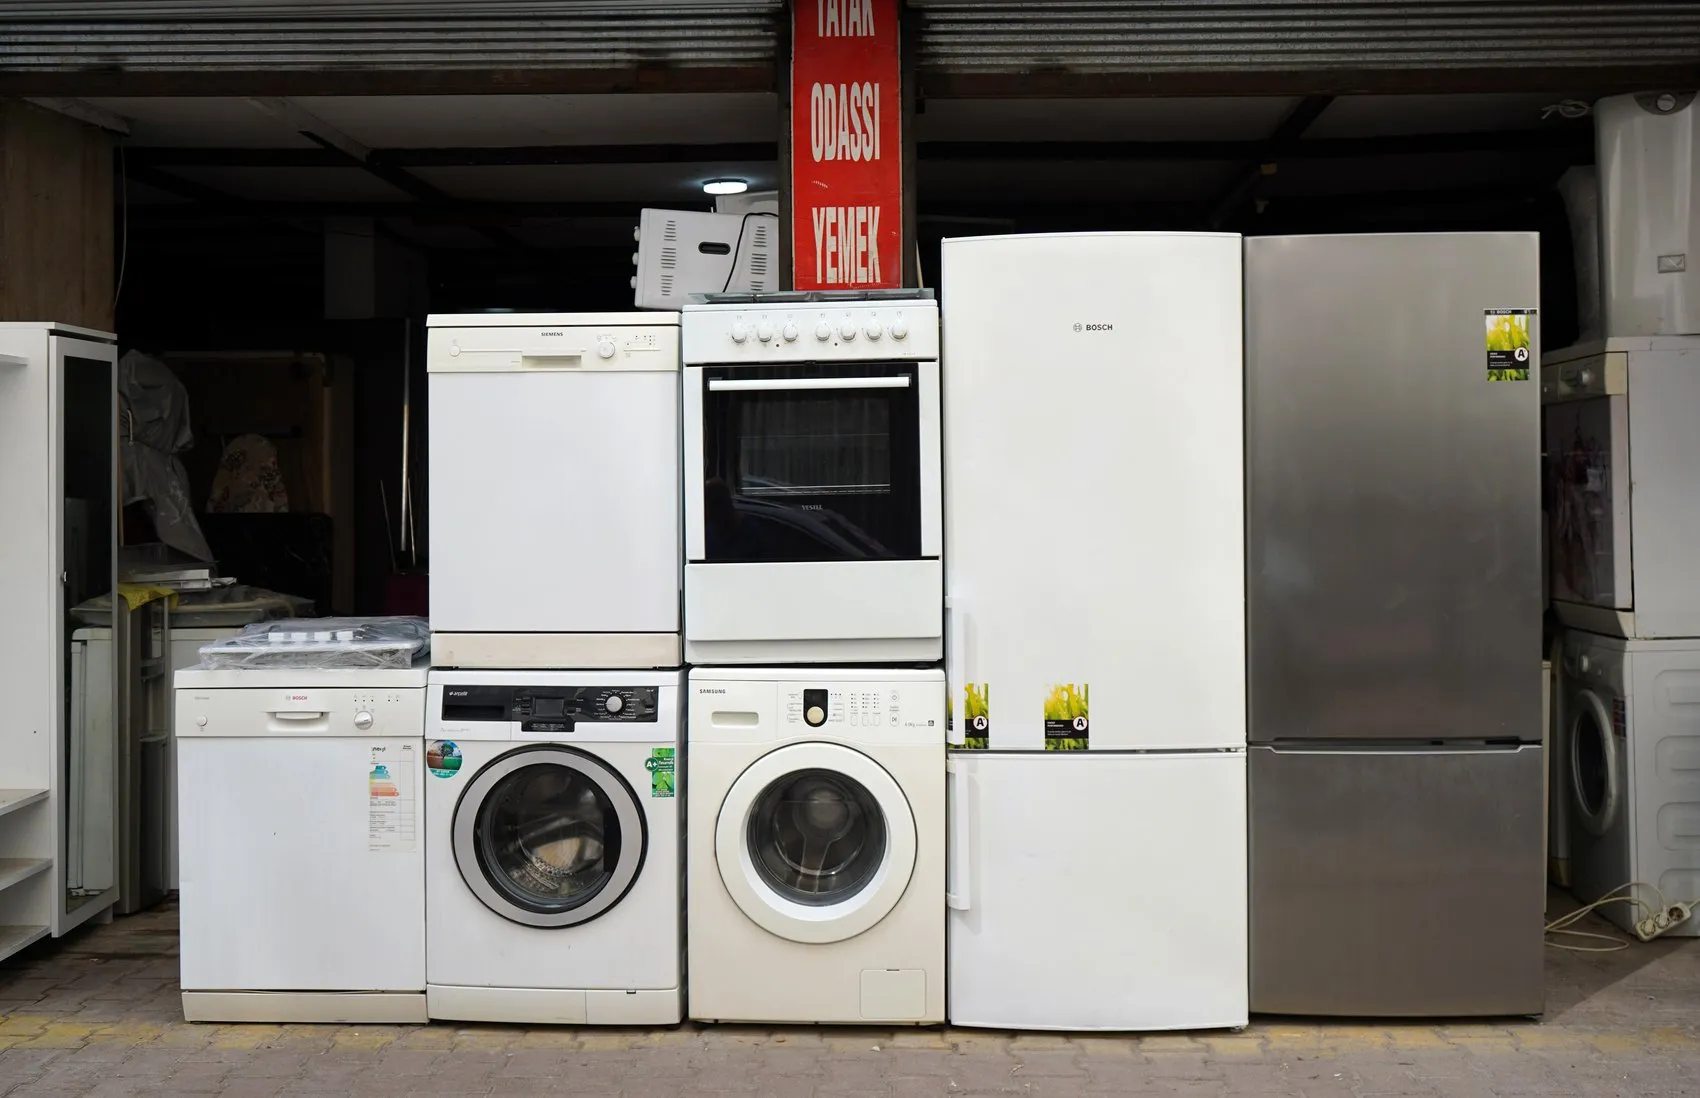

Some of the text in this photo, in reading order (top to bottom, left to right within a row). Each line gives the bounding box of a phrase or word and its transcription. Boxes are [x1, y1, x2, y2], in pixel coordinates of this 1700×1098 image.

[811, 81, 880, 163] ODASSI
[812, 206, 881, 284] YEMEK
[646, 760, 658, 768] A+
